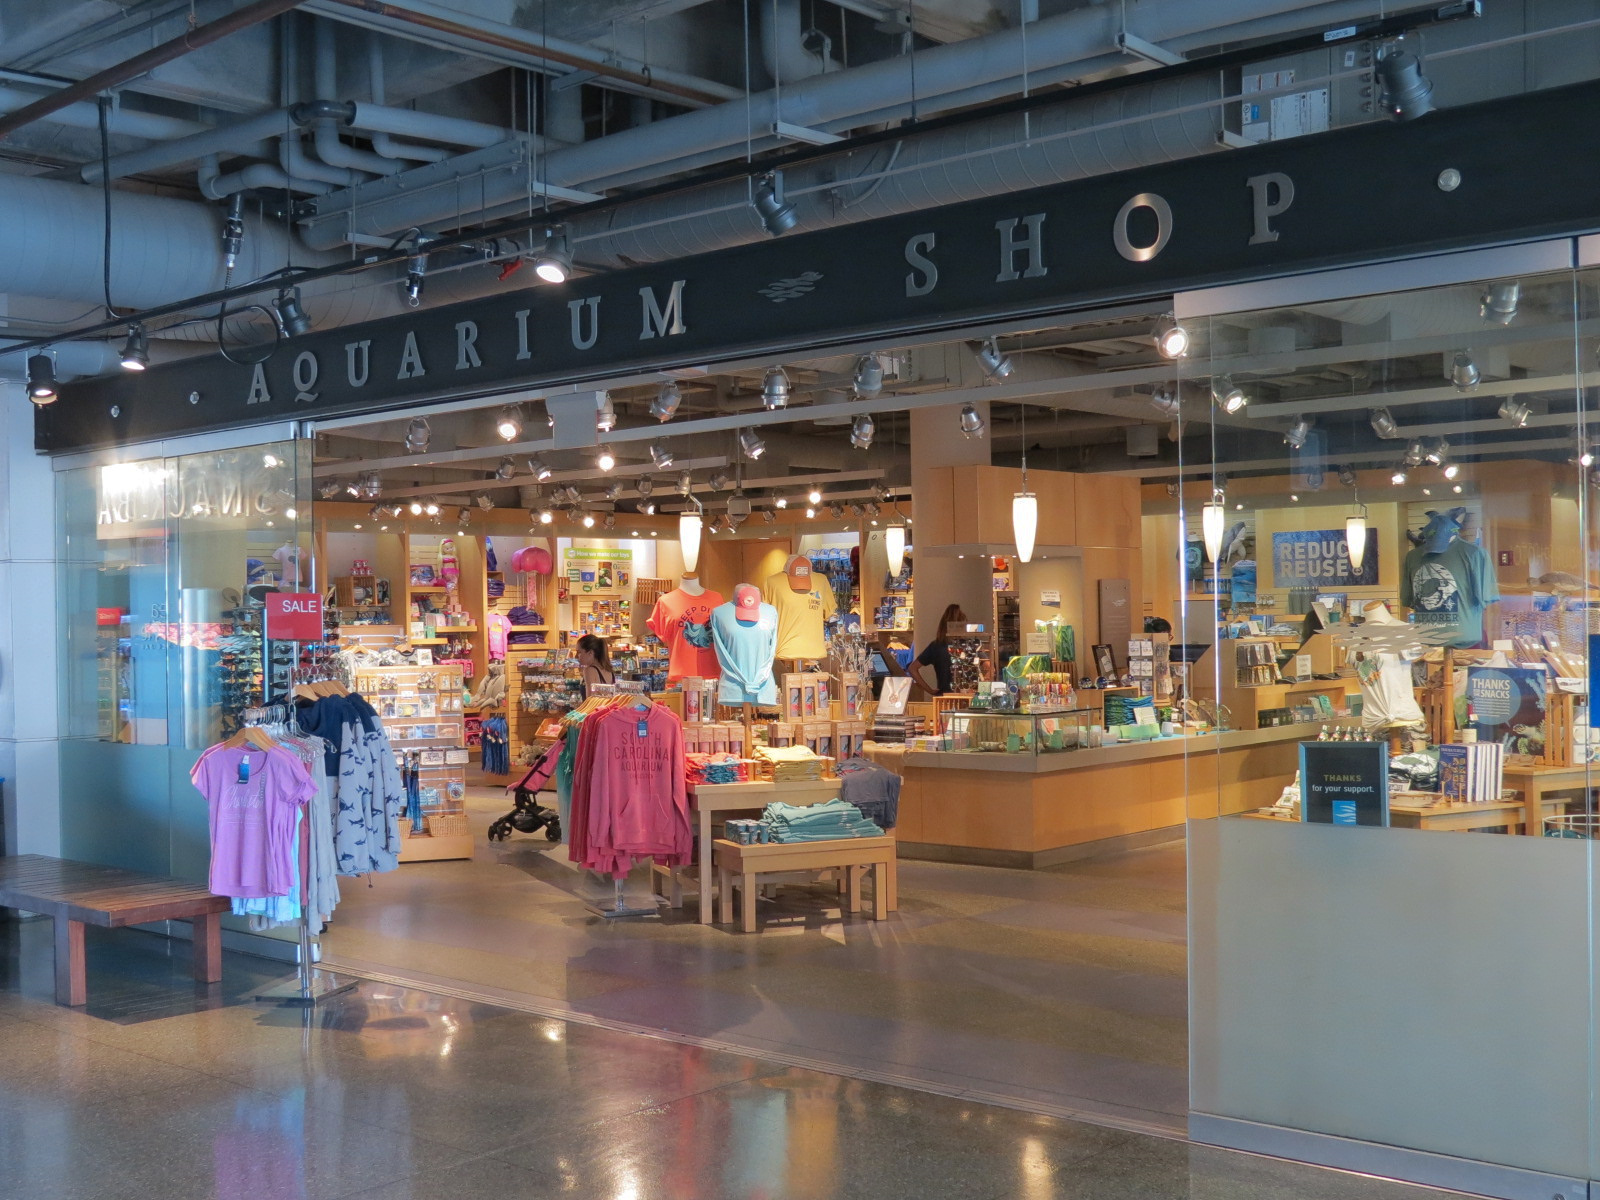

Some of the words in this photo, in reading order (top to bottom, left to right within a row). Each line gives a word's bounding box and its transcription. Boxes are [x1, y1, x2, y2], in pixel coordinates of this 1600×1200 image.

[247, 279, 687, 405] AQUARIUM
[904, 171, 1295, 298] SHOP
[1280, 540, 1349, 560] REDUC
[1280, 558, 1349, 578] REUSE
[282, 599, 318, 613] SALE
[678, 606, 697, 628] DEEP
[1472, 678, 1511, 690] THANKS
[1480, 689, 1510, 699] SNACKS
[614, 746, 669, 762] CAROLINA
[1323, 774, 1362, 782] THANKS
[1312, 784, 1322, 792] for
[1325, 785, 1341, 794] your
[1343, 786, 1375, 794] support.
